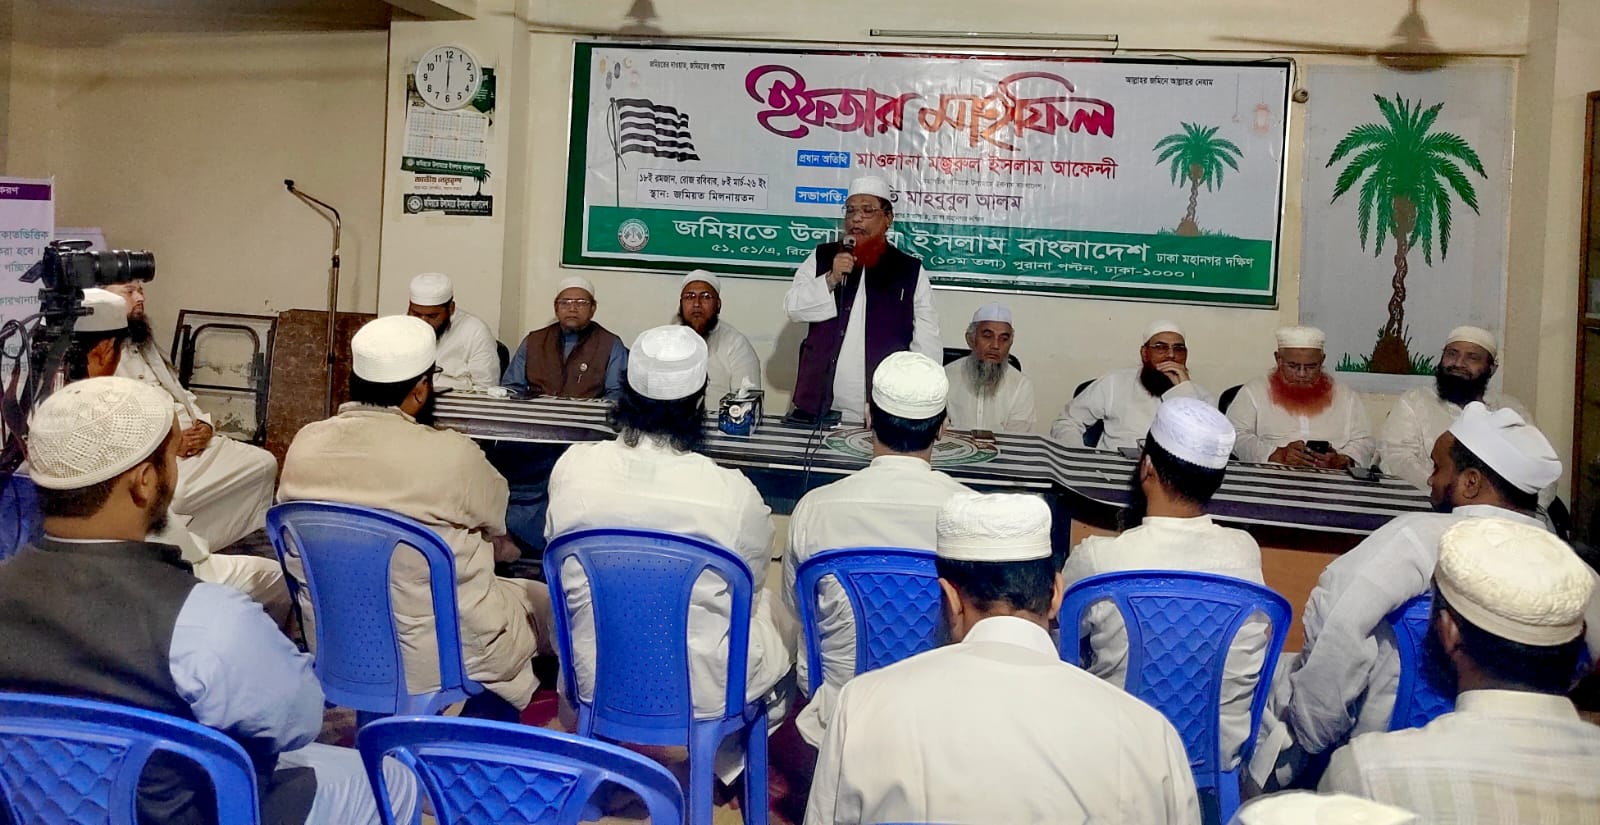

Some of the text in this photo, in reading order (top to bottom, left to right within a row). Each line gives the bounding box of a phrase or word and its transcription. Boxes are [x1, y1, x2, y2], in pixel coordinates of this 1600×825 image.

[435, 54, 442, 62] 11
[446, 51, 454, 59] 12
[459, 54, 463, 62] 1
[427, 63, 435, 72] 10
[466, 62, 471, 71] 2
[423, 73, 428, 81] 9
[470, 74, 474, 82] 3
[427, 84, 432, 93] 8
[465, 84, 469, 92] 4
[435, 91, 440, 99] 7
[445, 94, 450, 103] 6
[457, 92, 462, 100] 5
[745, 64, 925, 138] ইফতার
[799, 152, 848, 165] প্রধান অতিথি
[856, 152, 922, 170] মাওলানা
[988, 154, 1044, 176] ইসলাম
[1050, 157, 1118, 179] আফেন্দী
[639, 172, 653, 183] ১৮ই
[655, 174, 677, 184] রমজান,
[680, 175, 694, 184] রোজ
[696, 174, 719, 187] রবিবার,
[721, 176, 731, 187] ৮ই
[758, 178, 767, 189] ইং
[673, 188, 705, 200] জমিয়ত
[708, 190, 755, 202] মিলনায়তন
[905, 190, 971, 212] মাহবুবুল
[975, 193, 1023, 211] আলম
[672, 216, 782, 241] জমিয়তে
[911, 227, 1008, 254] ইসলাম
[1016, 236, 1151, 262] বাংলাদেশ
[1156, 253, 1255, 268] ঢাকা মহানগর দক্ষিণ
[930, 255, 967, 265] (১০ম
[971, 257, 1006, 270] তলা)
[1013, 261, 1053, 271] পুরানা
[1057, 261, 1098, 274] পল্টন,
[1104, 265, 1184, 279] ঢাকা-১০০০
